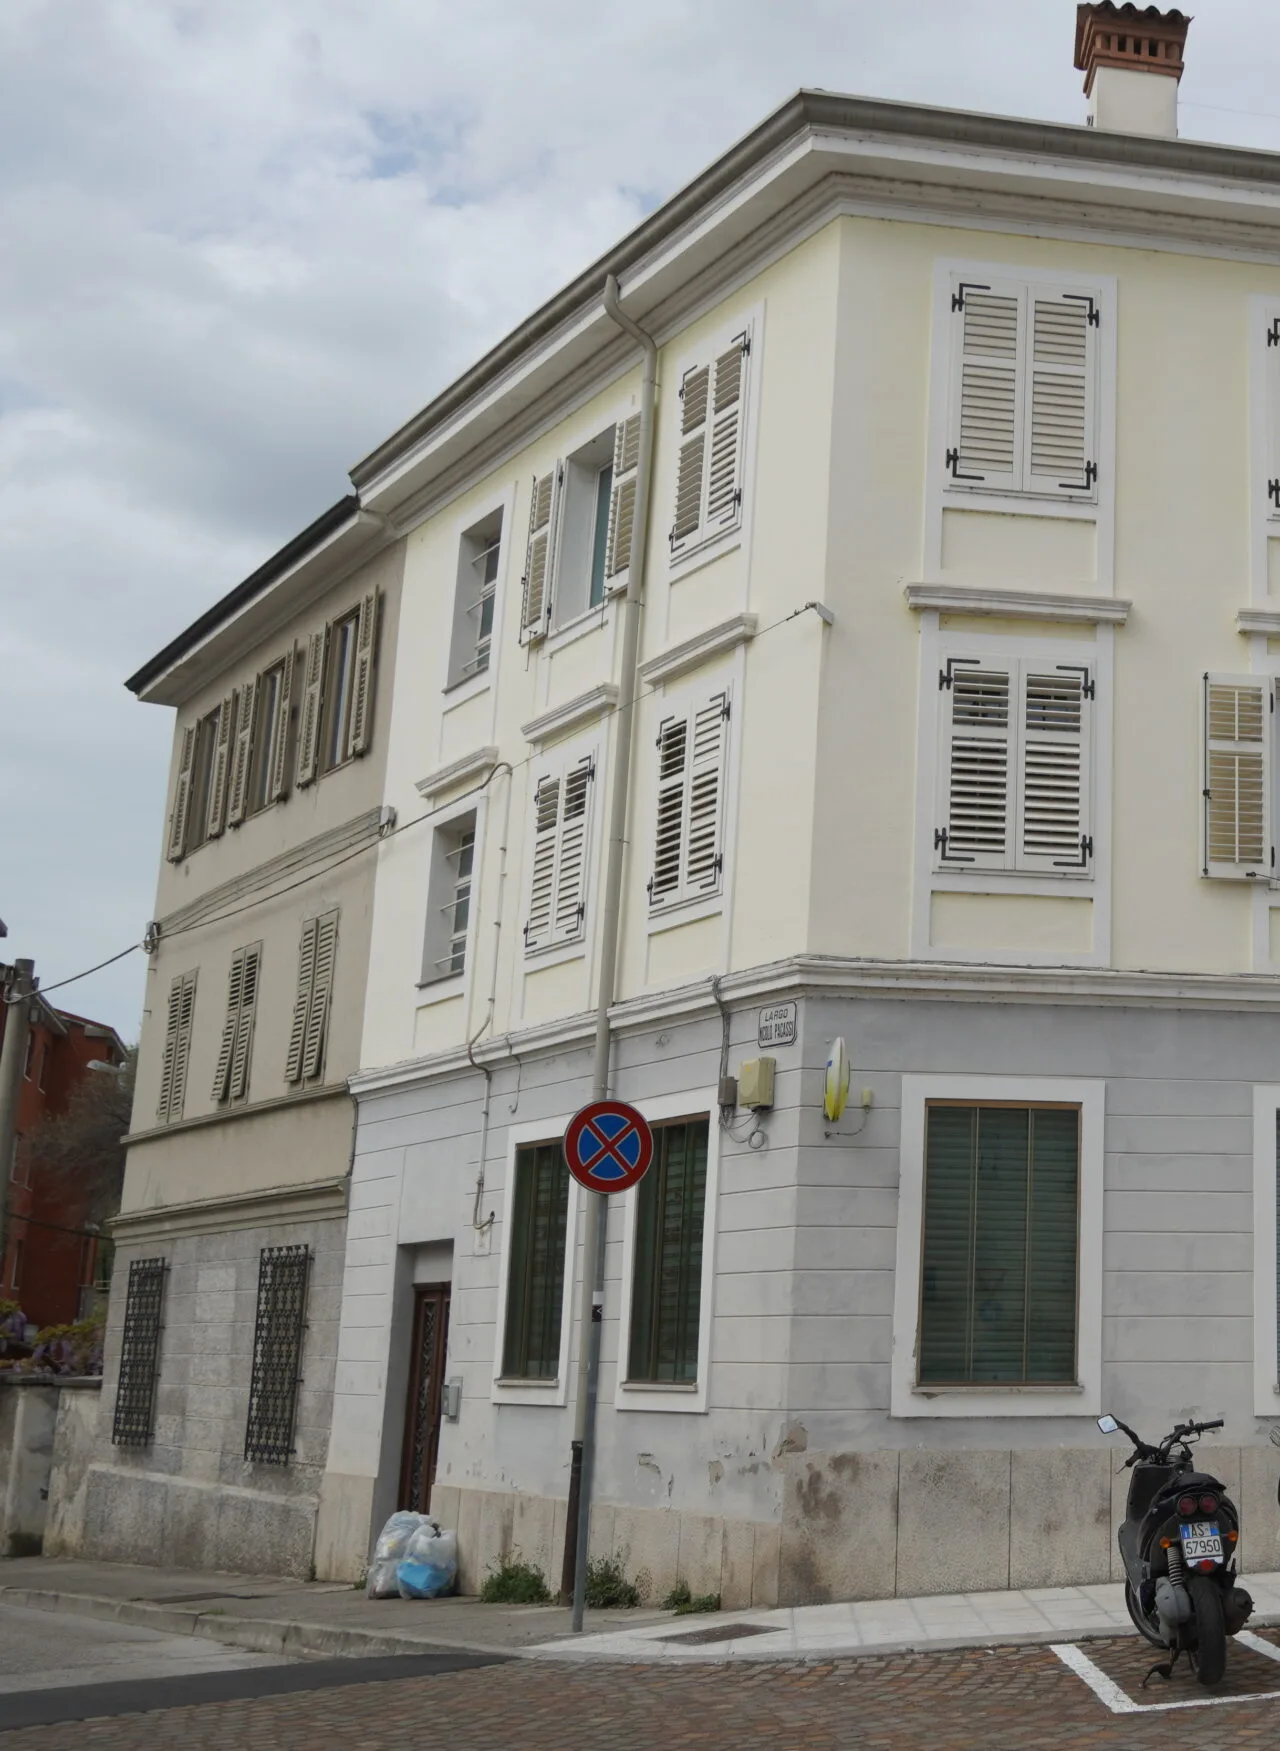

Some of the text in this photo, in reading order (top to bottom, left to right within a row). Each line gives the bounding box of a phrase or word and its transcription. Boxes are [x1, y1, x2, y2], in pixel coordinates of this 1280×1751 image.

[765, 1008, 788, 1021] LARGO
[1192, 1523, 1205, 1537] AS
[1186, 1539, 1221, 1555] 57950
